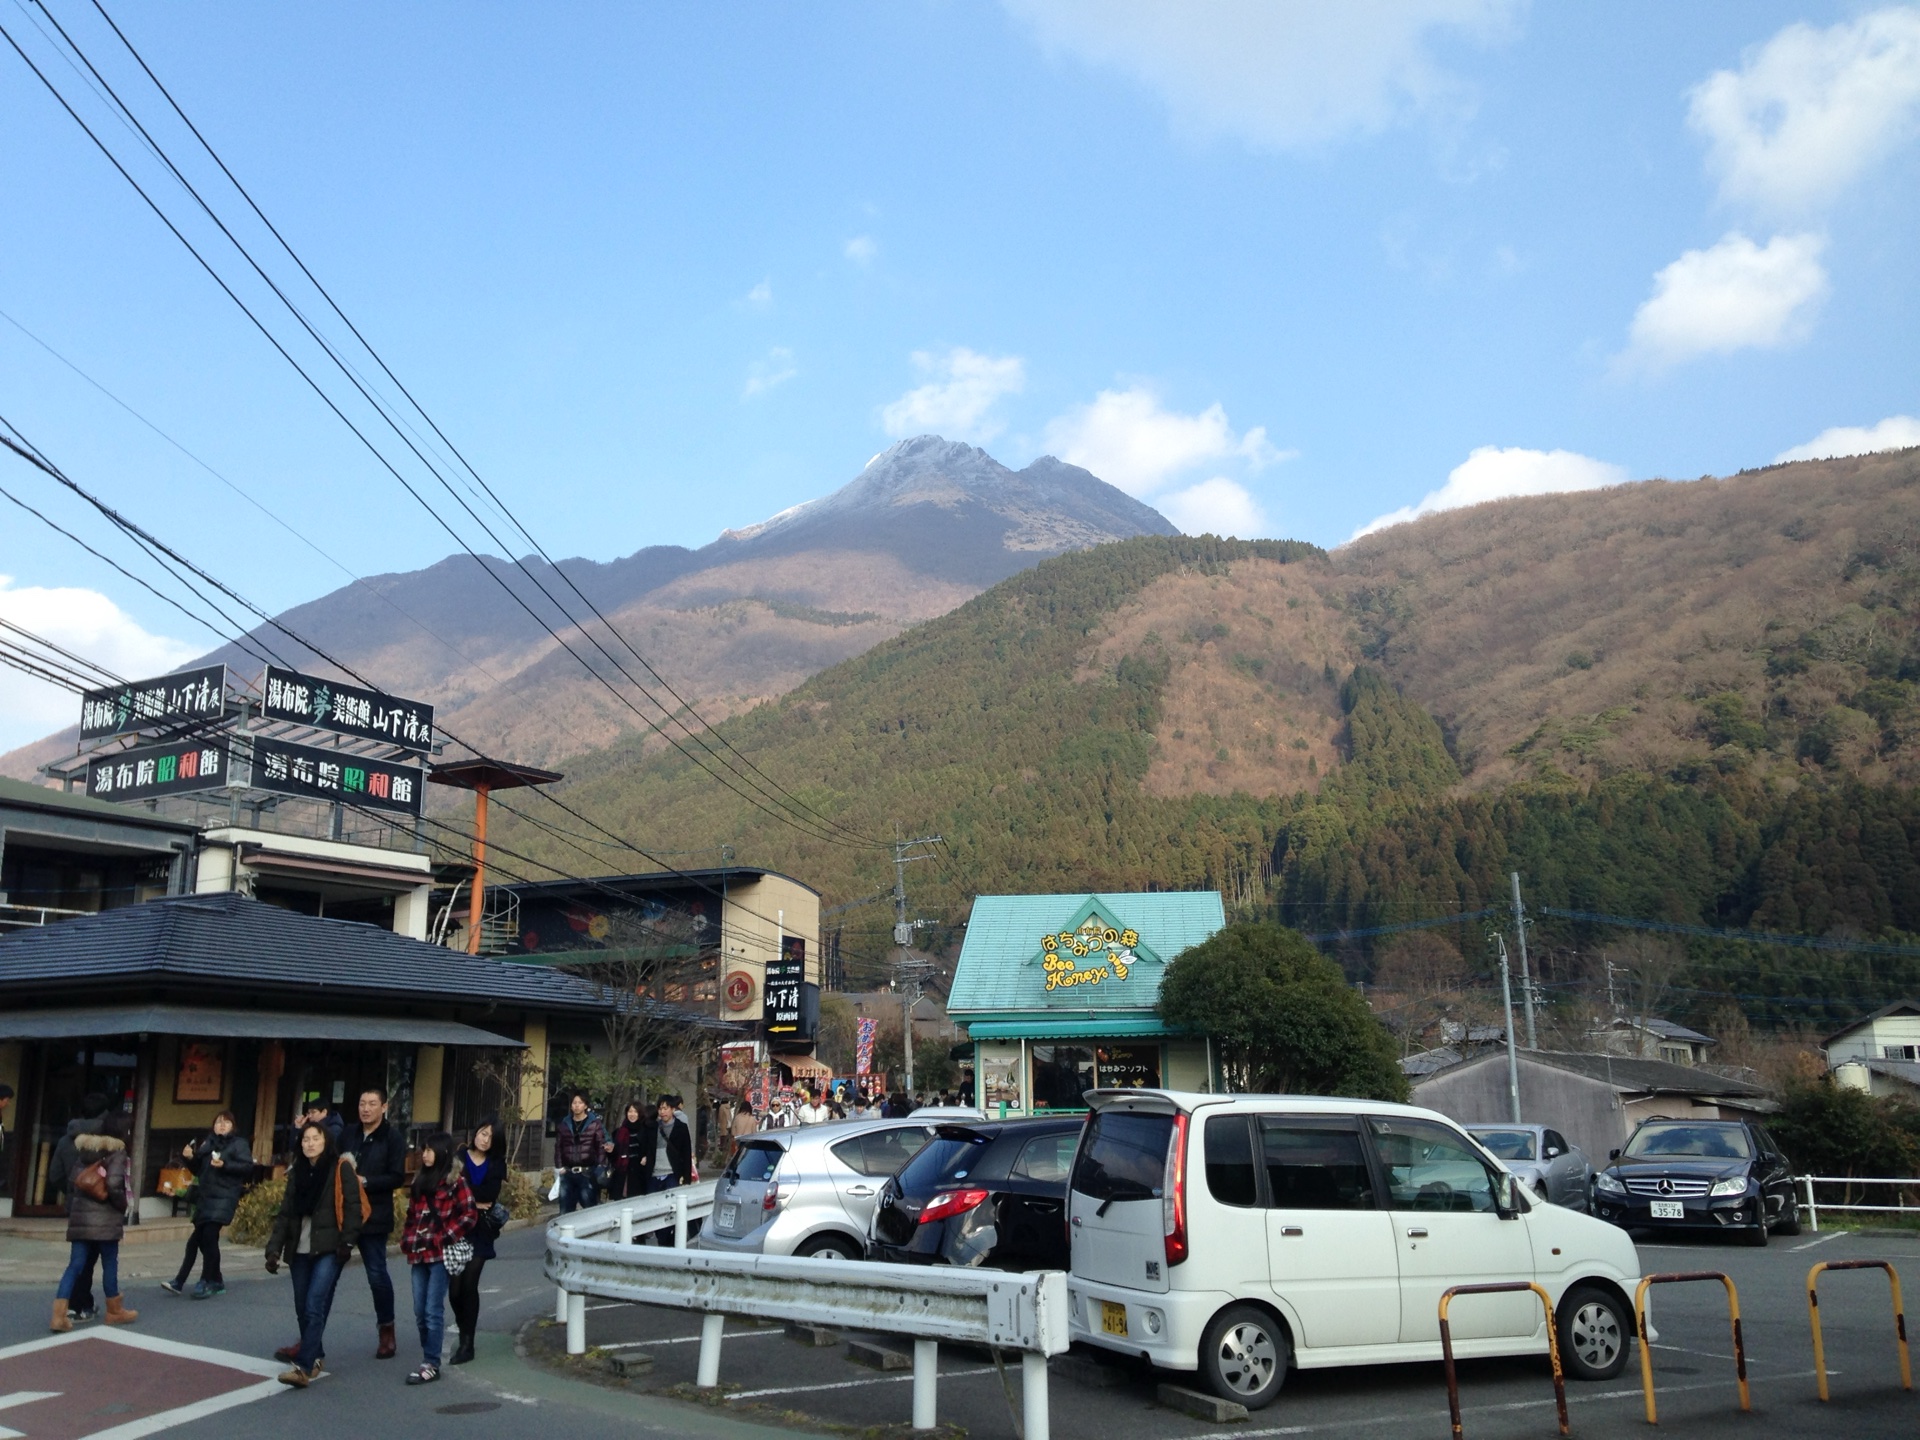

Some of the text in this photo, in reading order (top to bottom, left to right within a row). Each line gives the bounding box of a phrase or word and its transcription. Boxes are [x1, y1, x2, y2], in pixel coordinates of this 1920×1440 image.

[372, 706, 431, 743] 山下清展
[95, 748, 219, 793] 湯布院昭和館
[264, 751, 412, 803] 湯布院昭和館
[1041, 927, 1140, 958] はちみつの森
[1043, 952, 1075, 972] Bee
[766, 986, 800, 1009] 山下清
[861, 1022, 873, 1056] おめん
[1658, 1208, 1682, 1217] 35-78
